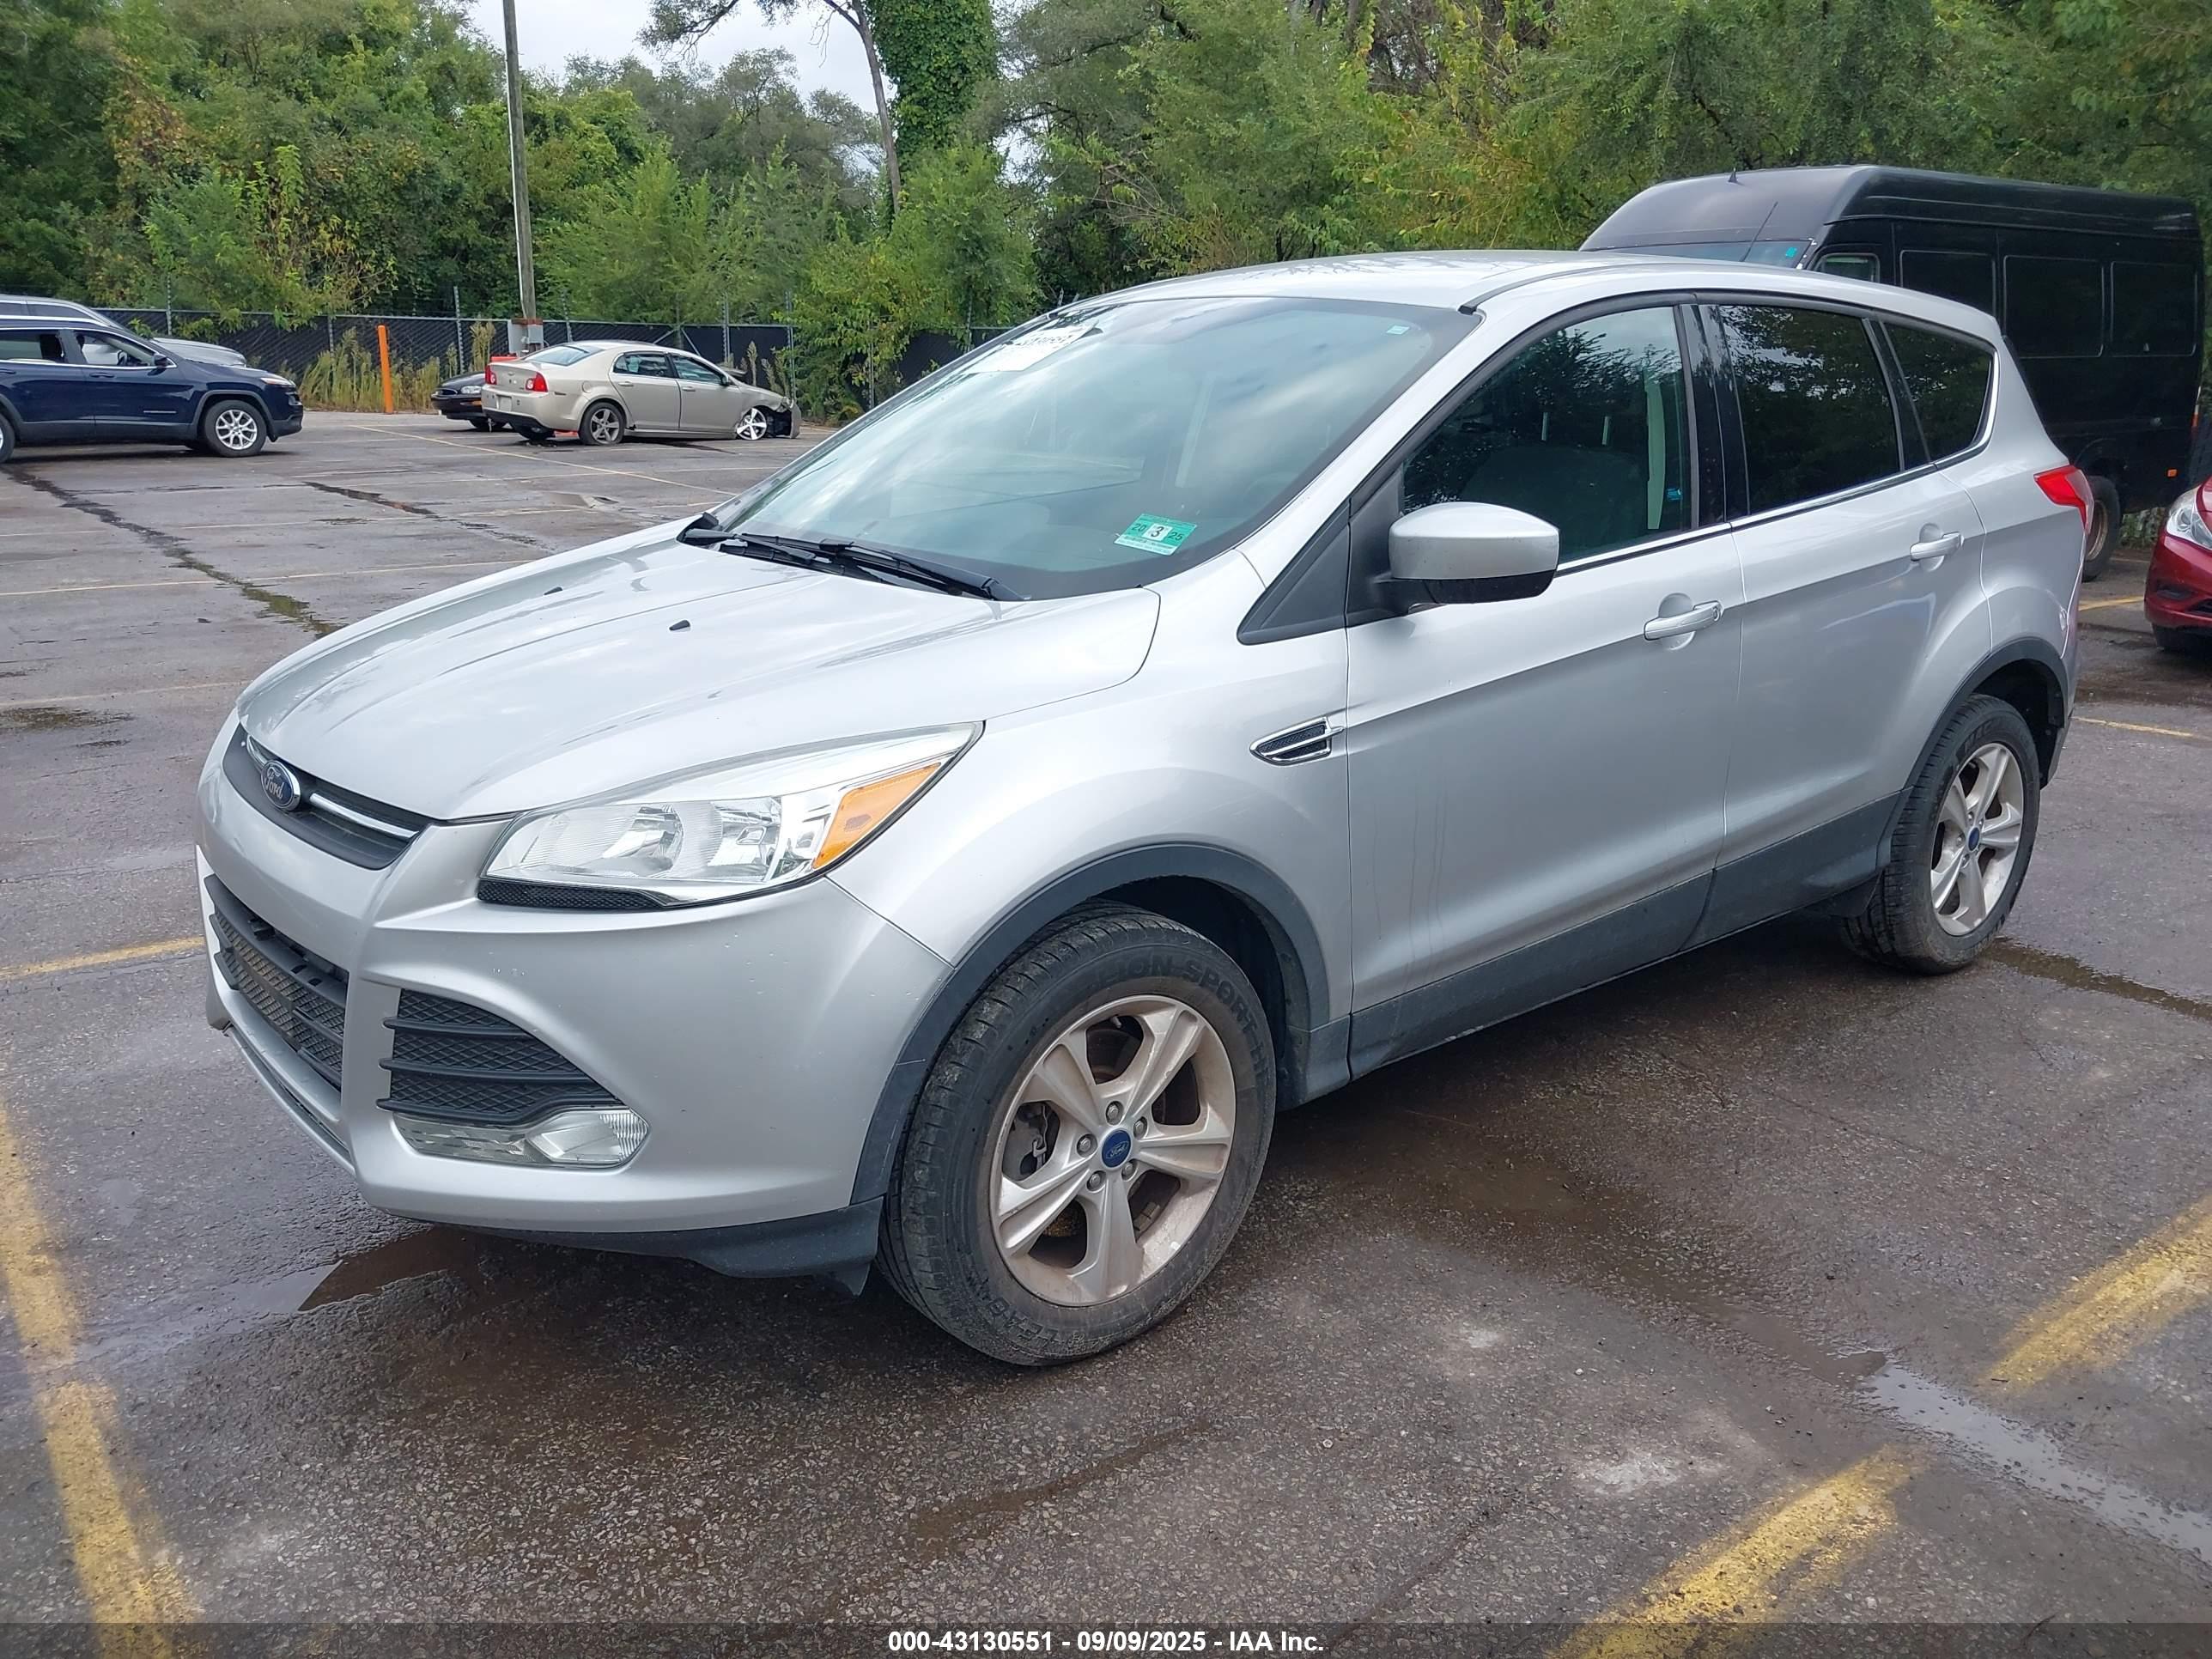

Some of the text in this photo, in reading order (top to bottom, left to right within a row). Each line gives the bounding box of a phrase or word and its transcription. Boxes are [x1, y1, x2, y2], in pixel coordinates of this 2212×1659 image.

[1131, 522, 1183, 542] 20 3 25
[264, 766, 284, 800] Ford
